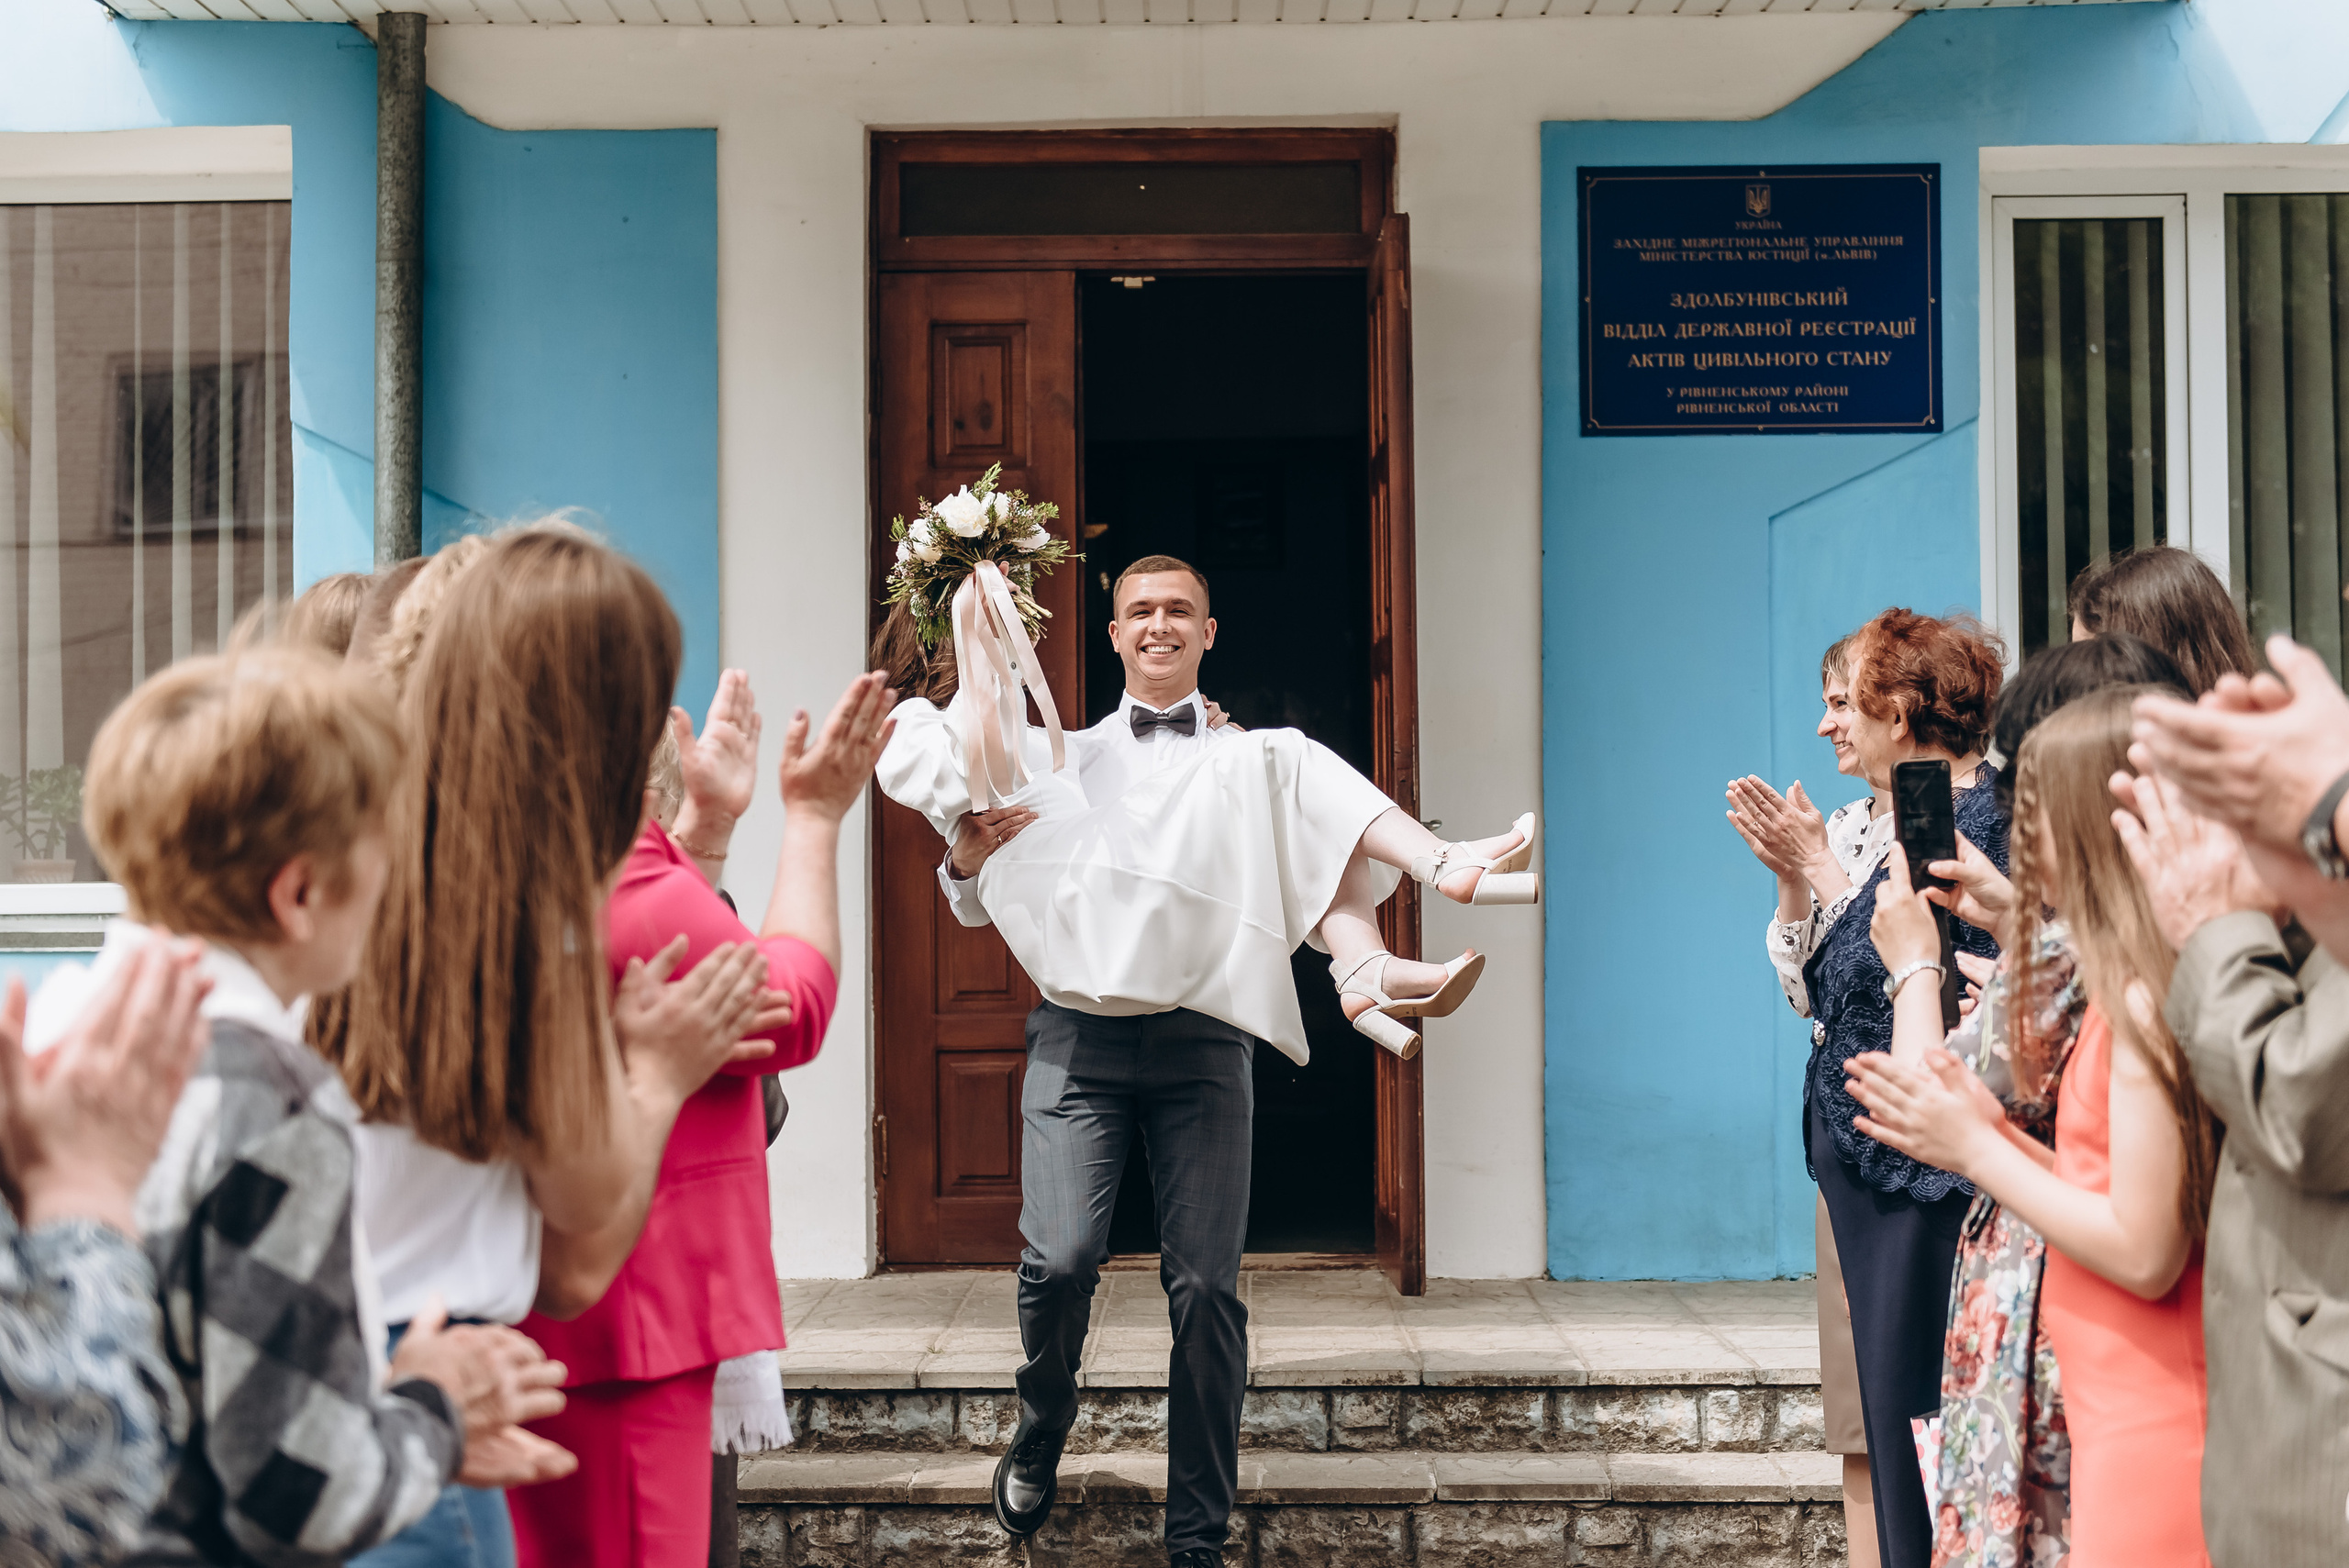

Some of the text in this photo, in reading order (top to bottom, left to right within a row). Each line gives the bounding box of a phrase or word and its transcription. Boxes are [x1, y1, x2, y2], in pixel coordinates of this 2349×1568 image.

[1735, 219, 1783, 230] УКРАЇНА
[1614, 236, 1904, 250] ЗАХІДНЕ МІЖРЕГІОНАЛЬНЕ УПРАВЛІННЯ
[1639, 250, 1743, 262] МІНІСТЕРСТВА
[1747, 248, 1810, 263] ЮСТИЦІЇ
[1670, 287, 1849, 310] ЗДОЛБУНІВСЬКИЙ
[1603, 317, 1917, 340] ВІДДІЛ ДЕРЖАВНОЇ РЕЄСТРАЦІЇ
[1627, 350, 1893, 372] АКТІВ ЦИВІЛЬНОГО СТАНУ
[1666, 384, 1849, 398] У РІВНЕНСЬКОМУ РАЙОНІ
[1676, 401, 1839, 414] РІВНЕНСЬКОЇ ОБЛАСТІ
